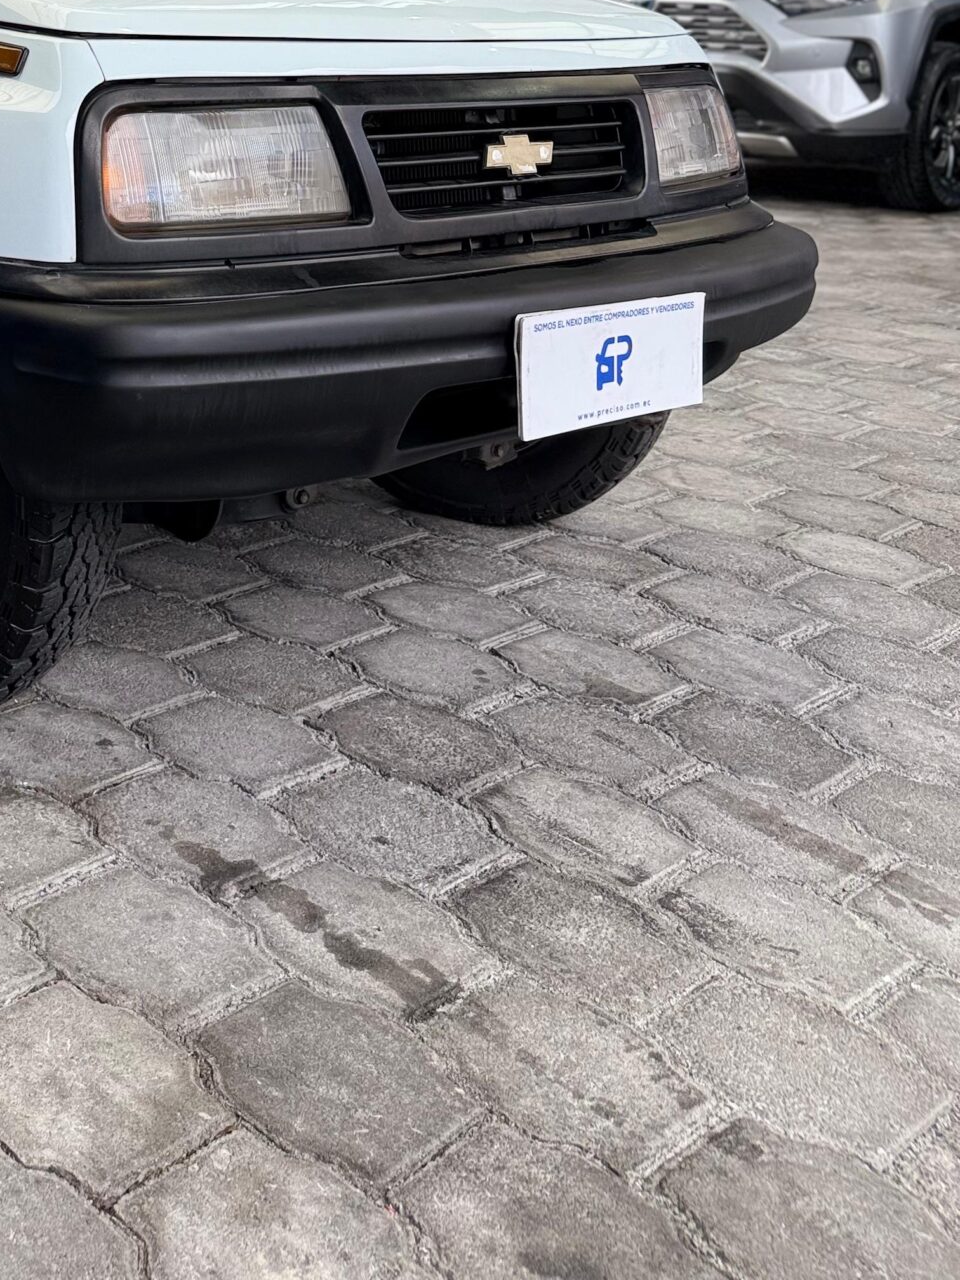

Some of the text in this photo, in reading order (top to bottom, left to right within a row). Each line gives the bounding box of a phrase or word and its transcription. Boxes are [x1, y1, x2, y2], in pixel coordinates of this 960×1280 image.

[533, 322, 557, 333] SOMOS
[557, 320, 566, 329] EL
[565, 317, 583, 327] NEXO
[583, 314, 604, 326] ENTRE
[603, 306, 650, 322] COMPRADORES
[655, 301, 695, 314] VENDEDORES
